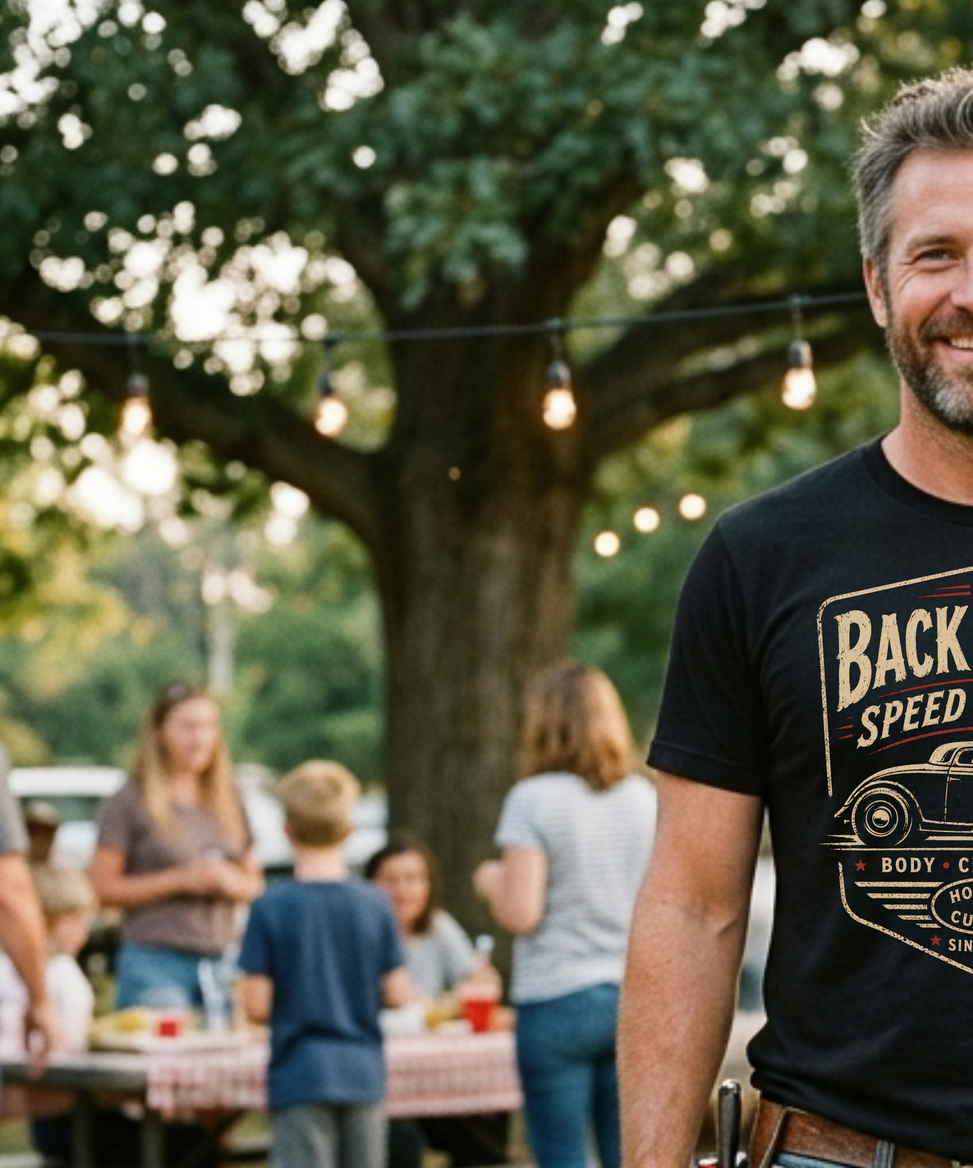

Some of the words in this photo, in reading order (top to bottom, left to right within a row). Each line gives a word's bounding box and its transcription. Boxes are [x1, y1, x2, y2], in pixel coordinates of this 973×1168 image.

[834, 605, 971, 712] BACK
[856, 688, 967, 749] SPEED
[881, 857, 936, 873] BODY
